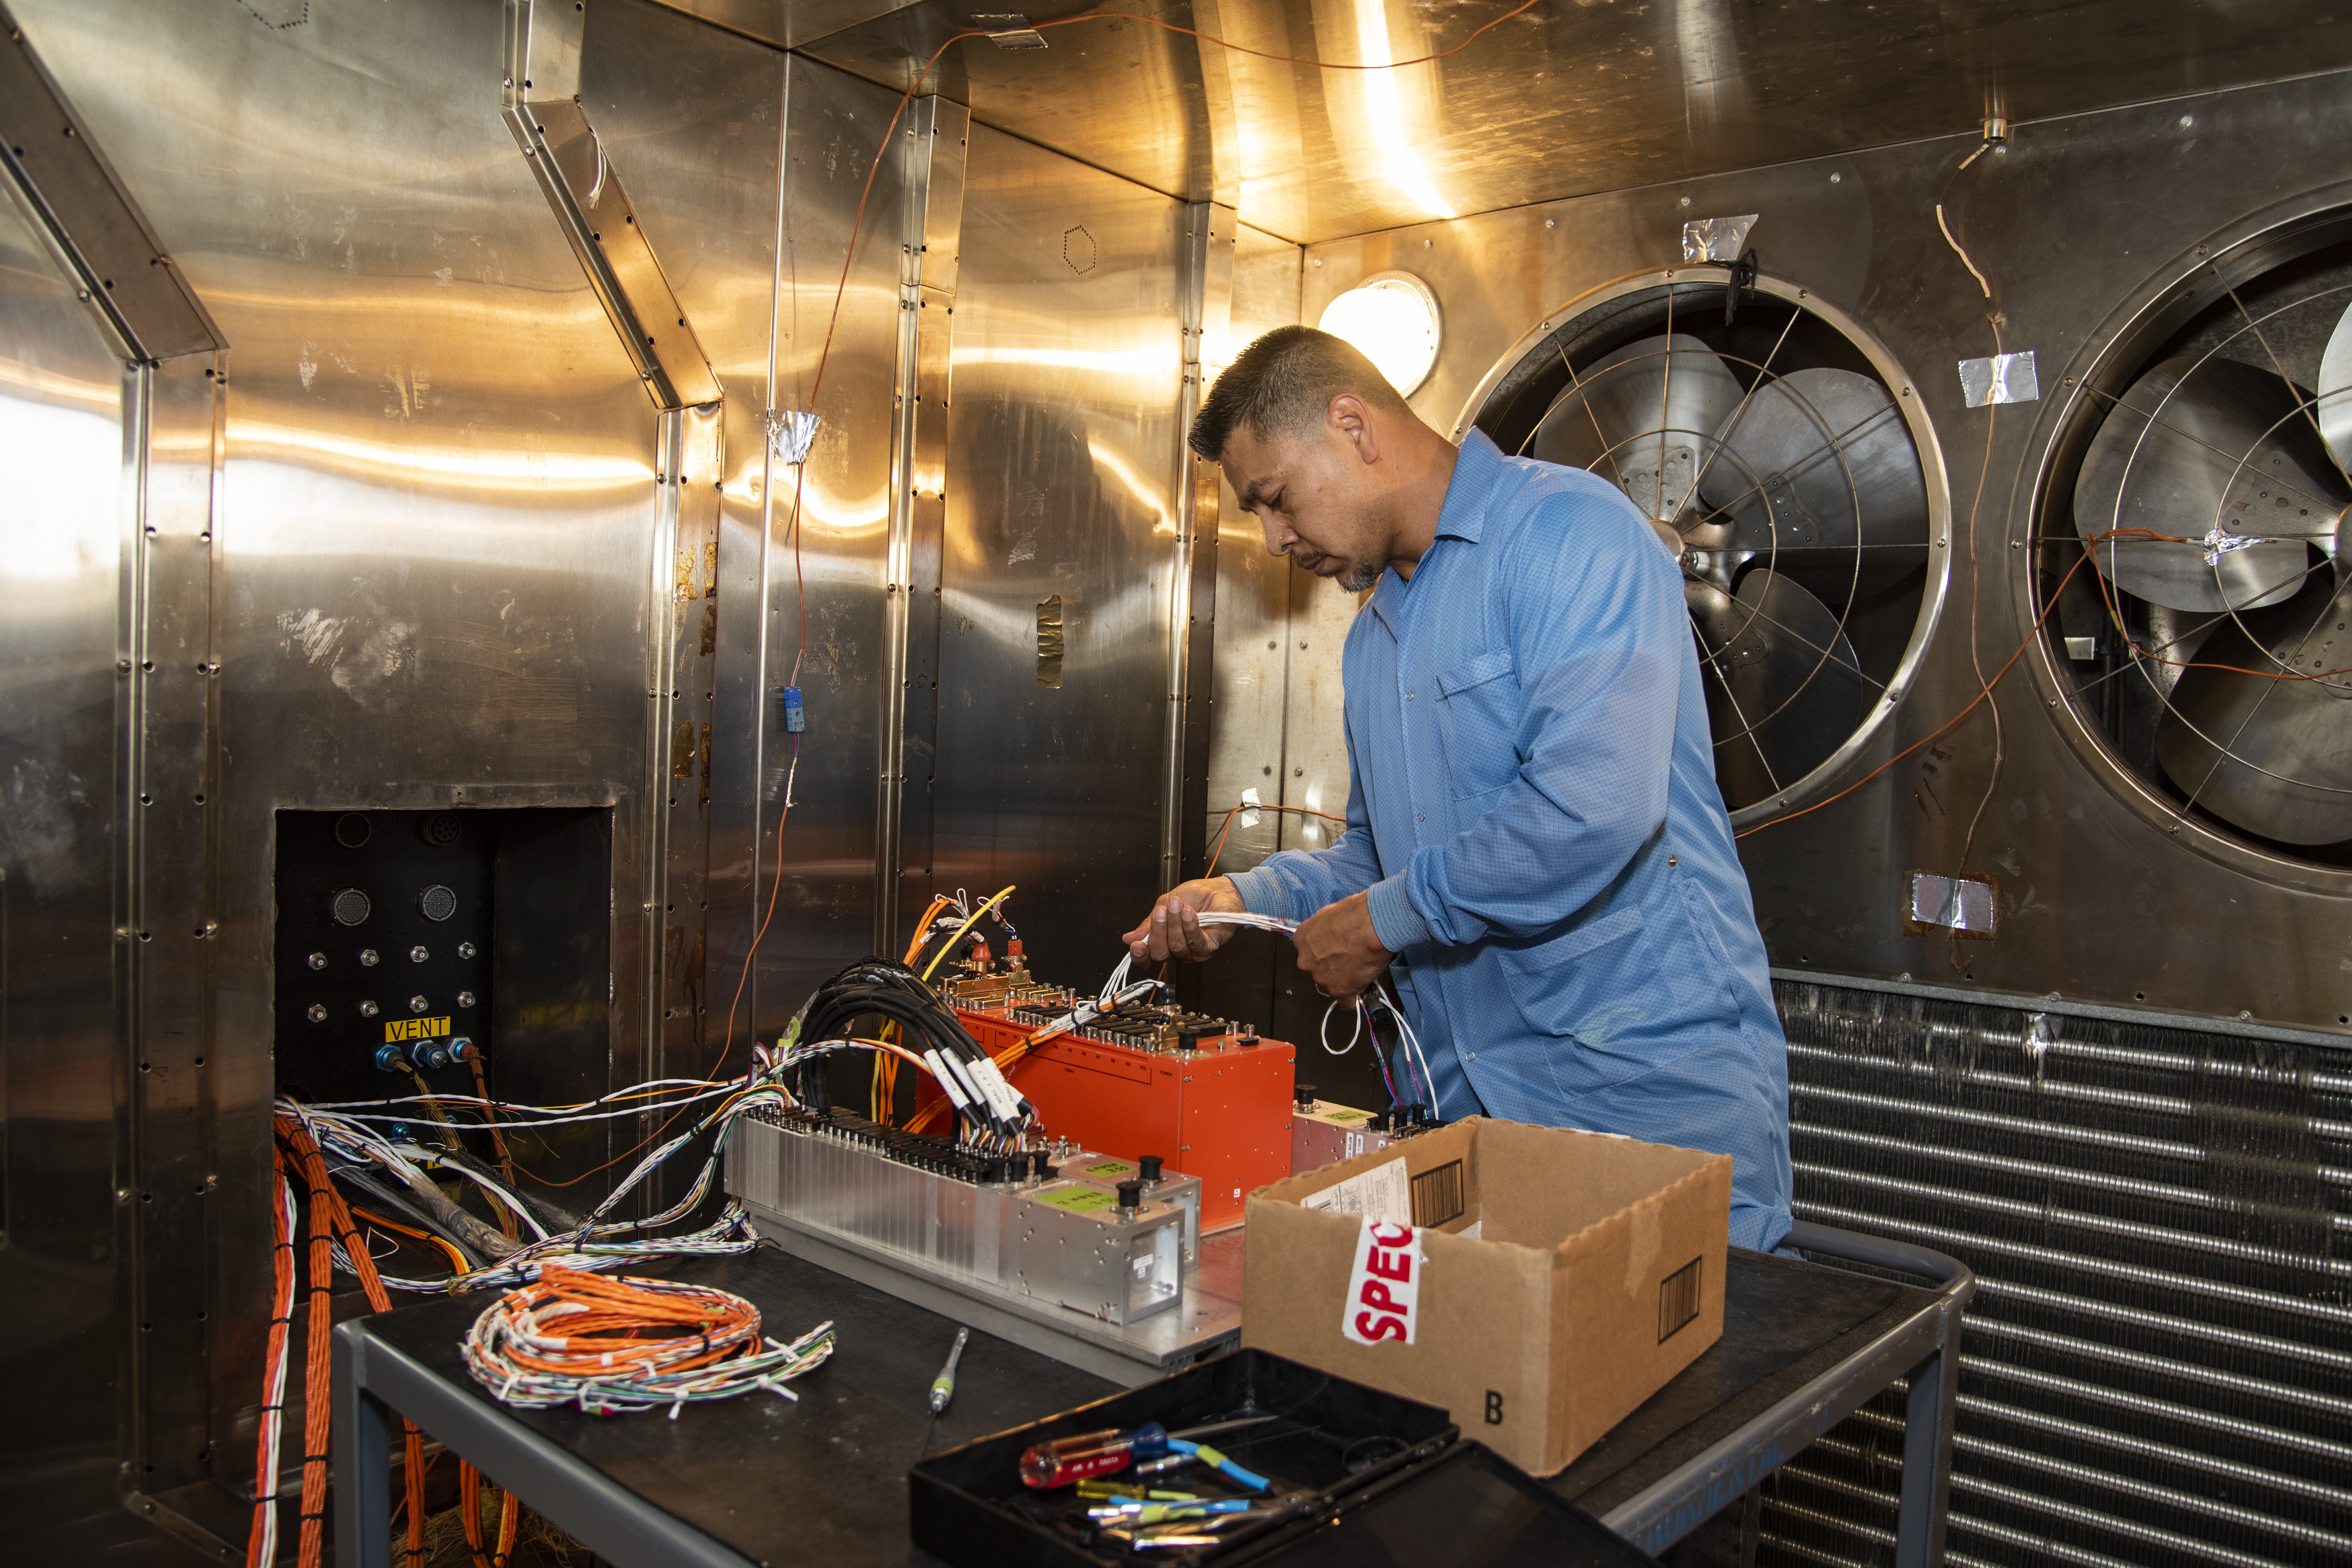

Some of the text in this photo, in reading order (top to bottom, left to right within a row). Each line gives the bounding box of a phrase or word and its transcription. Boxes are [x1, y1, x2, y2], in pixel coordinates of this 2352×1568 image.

[390, 1017, 447, 1041] VENT
[1044, 1024, 1058, 1033] Trigger
[946, 1077, 957, 1091] RDAU
[991, 1089, 1003, 1104] RDAU
[1005, 1086, 1013, 1101] RDAU
[1355, 1222, 1413, 1342] SPEC
[1485, 1389, 1504, 1425] B
